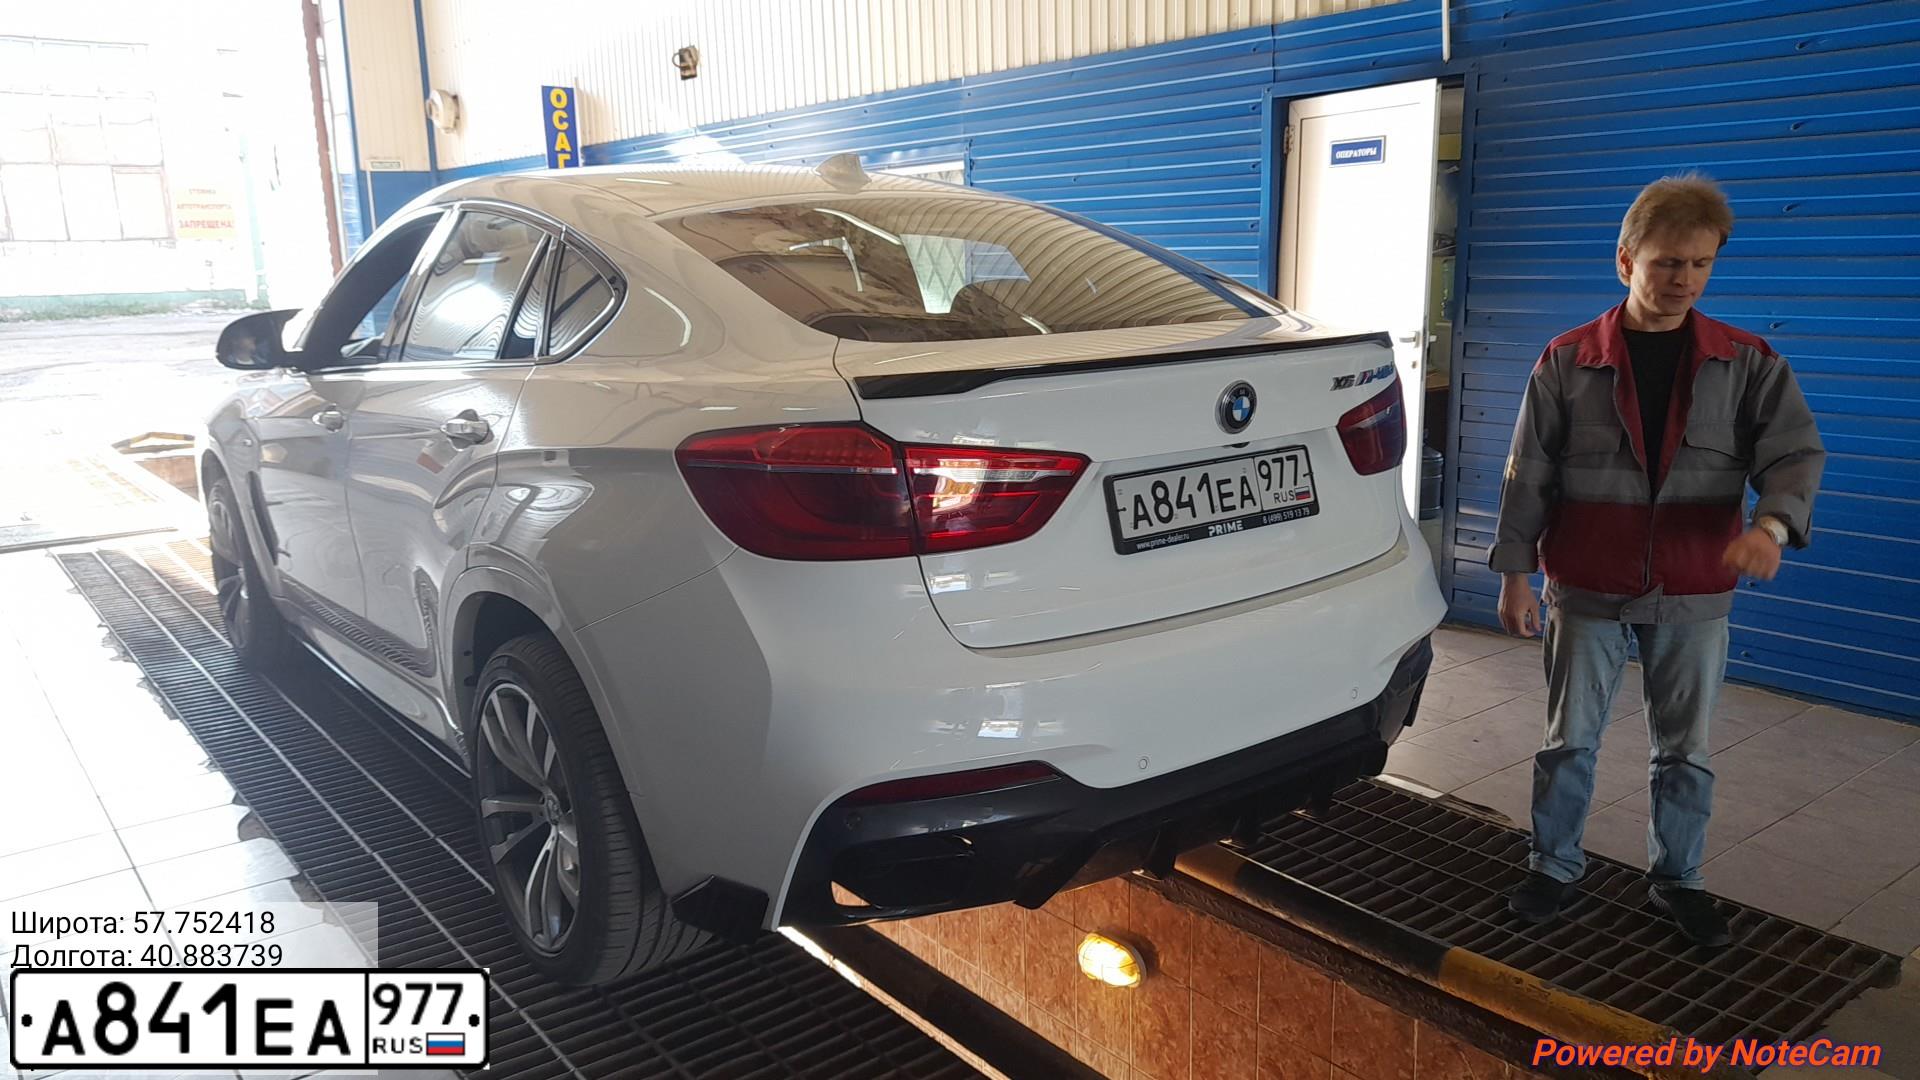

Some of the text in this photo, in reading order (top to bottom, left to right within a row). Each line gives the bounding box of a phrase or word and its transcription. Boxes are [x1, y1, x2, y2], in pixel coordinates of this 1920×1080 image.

[1335, 146, 1377, 160] ОПЕРАТОРЫ
[1257, 454, 1299, 492] 977
[1273, 489, 1295, 504] RUS
[1283, 510, 1294, 520] 519
[1207, 519, 1244, 537] PRIME
